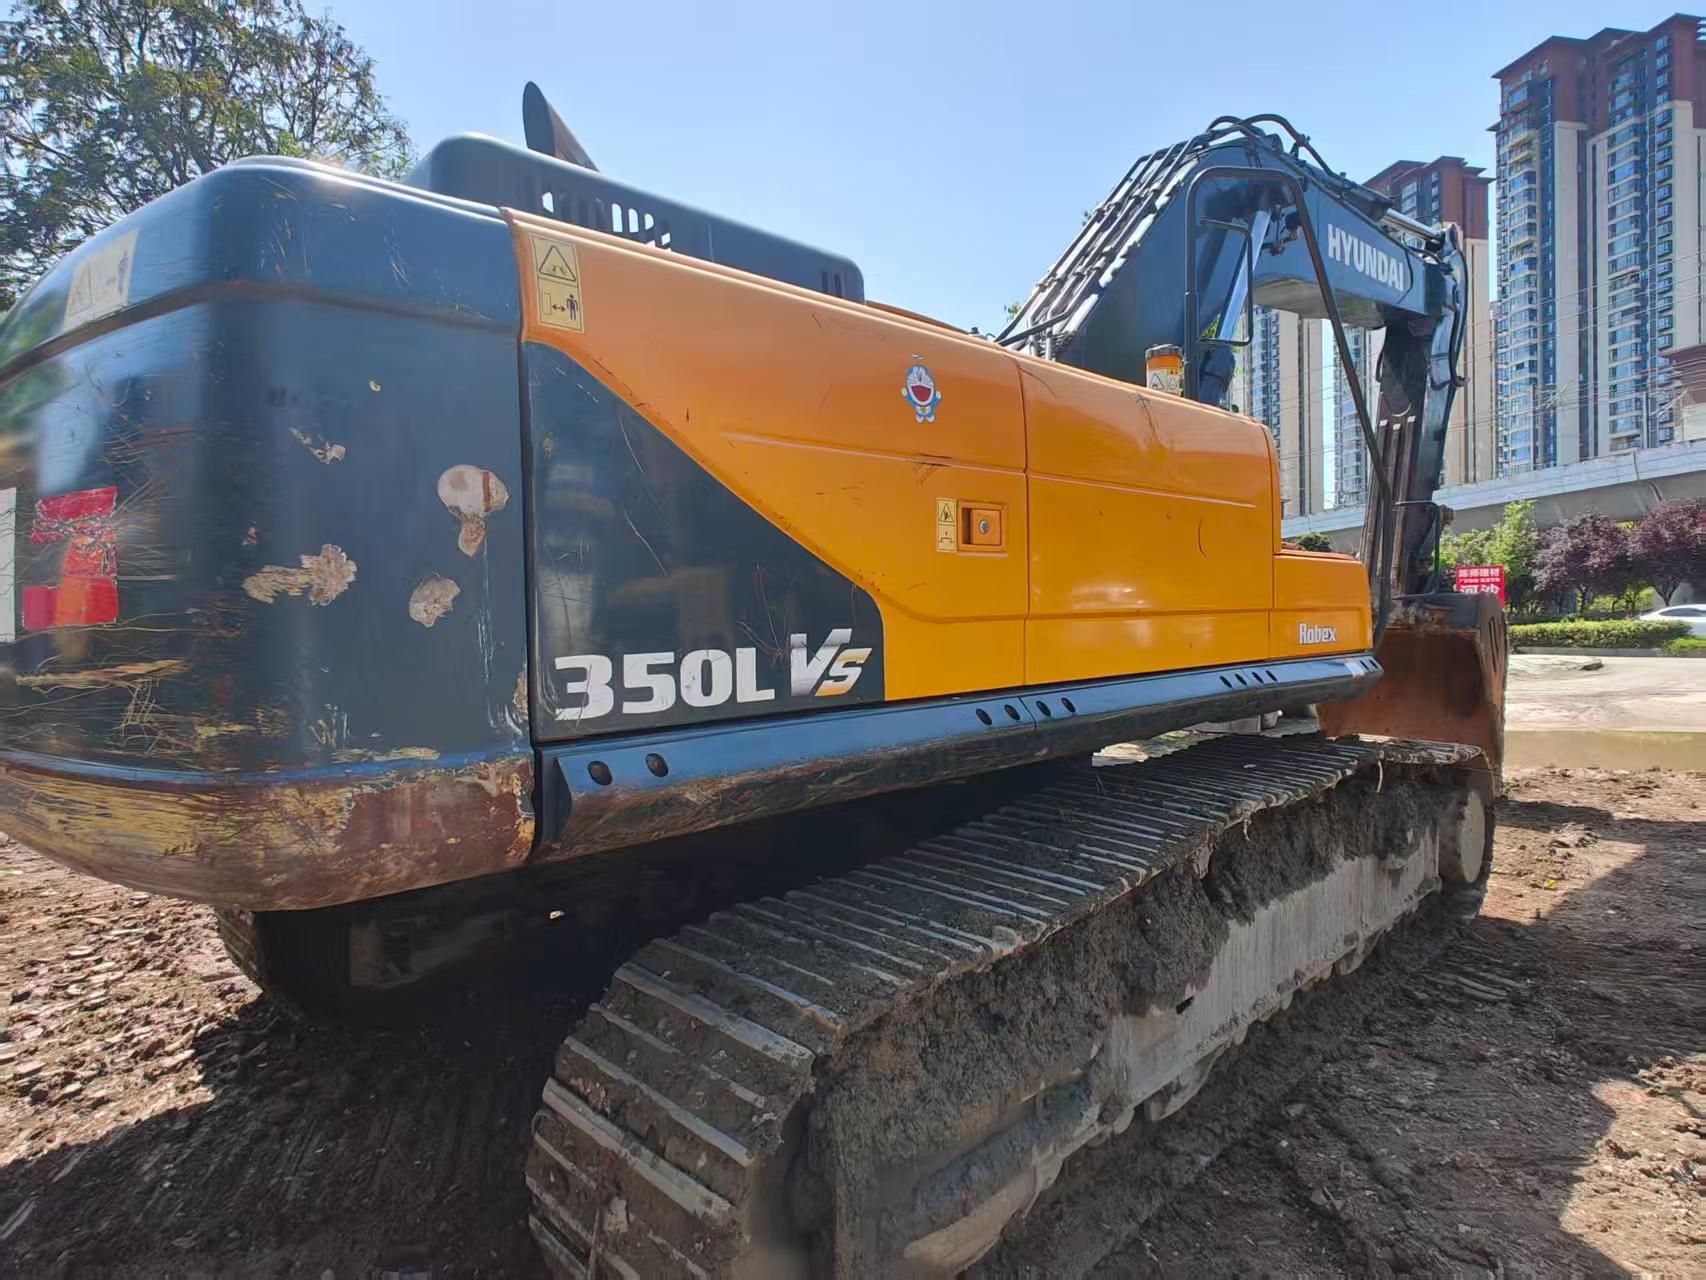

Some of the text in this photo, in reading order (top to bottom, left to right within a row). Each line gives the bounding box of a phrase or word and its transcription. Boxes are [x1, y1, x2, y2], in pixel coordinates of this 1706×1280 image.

[1327, 223, 1404, 292] HYUNDAI
[1299, 623, 1336, 645] Robex
[554, 647, 776, 722] 350L
